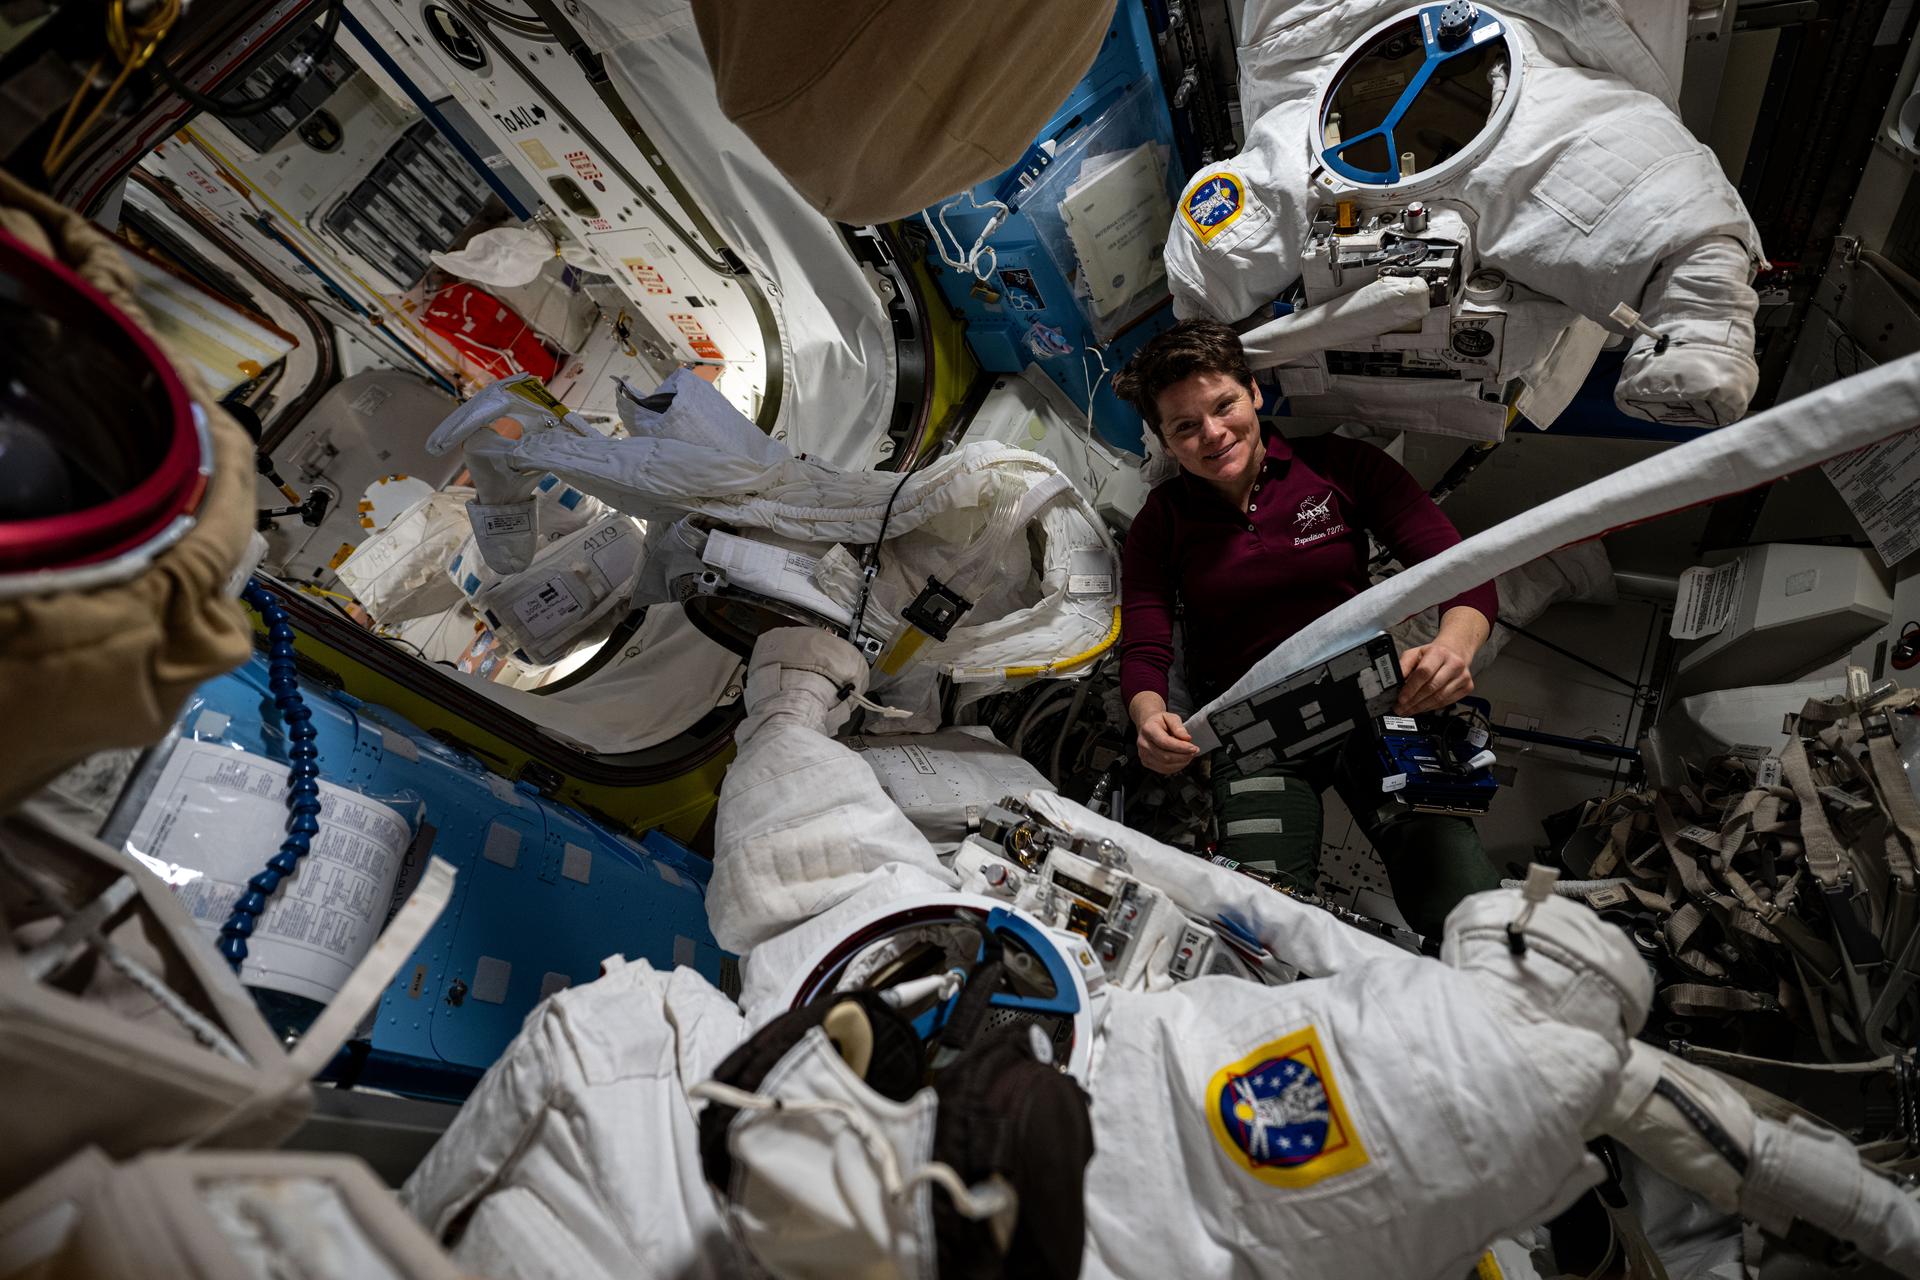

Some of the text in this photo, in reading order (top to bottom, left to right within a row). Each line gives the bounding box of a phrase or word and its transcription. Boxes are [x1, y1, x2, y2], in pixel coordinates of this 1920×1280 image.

[493, 105, 540, 134] To A/L
[1297, 504, 1329, 520] NASA
[583, 526, 618, 551] 4179
[1294, 532, 1327, 546] Expedition
